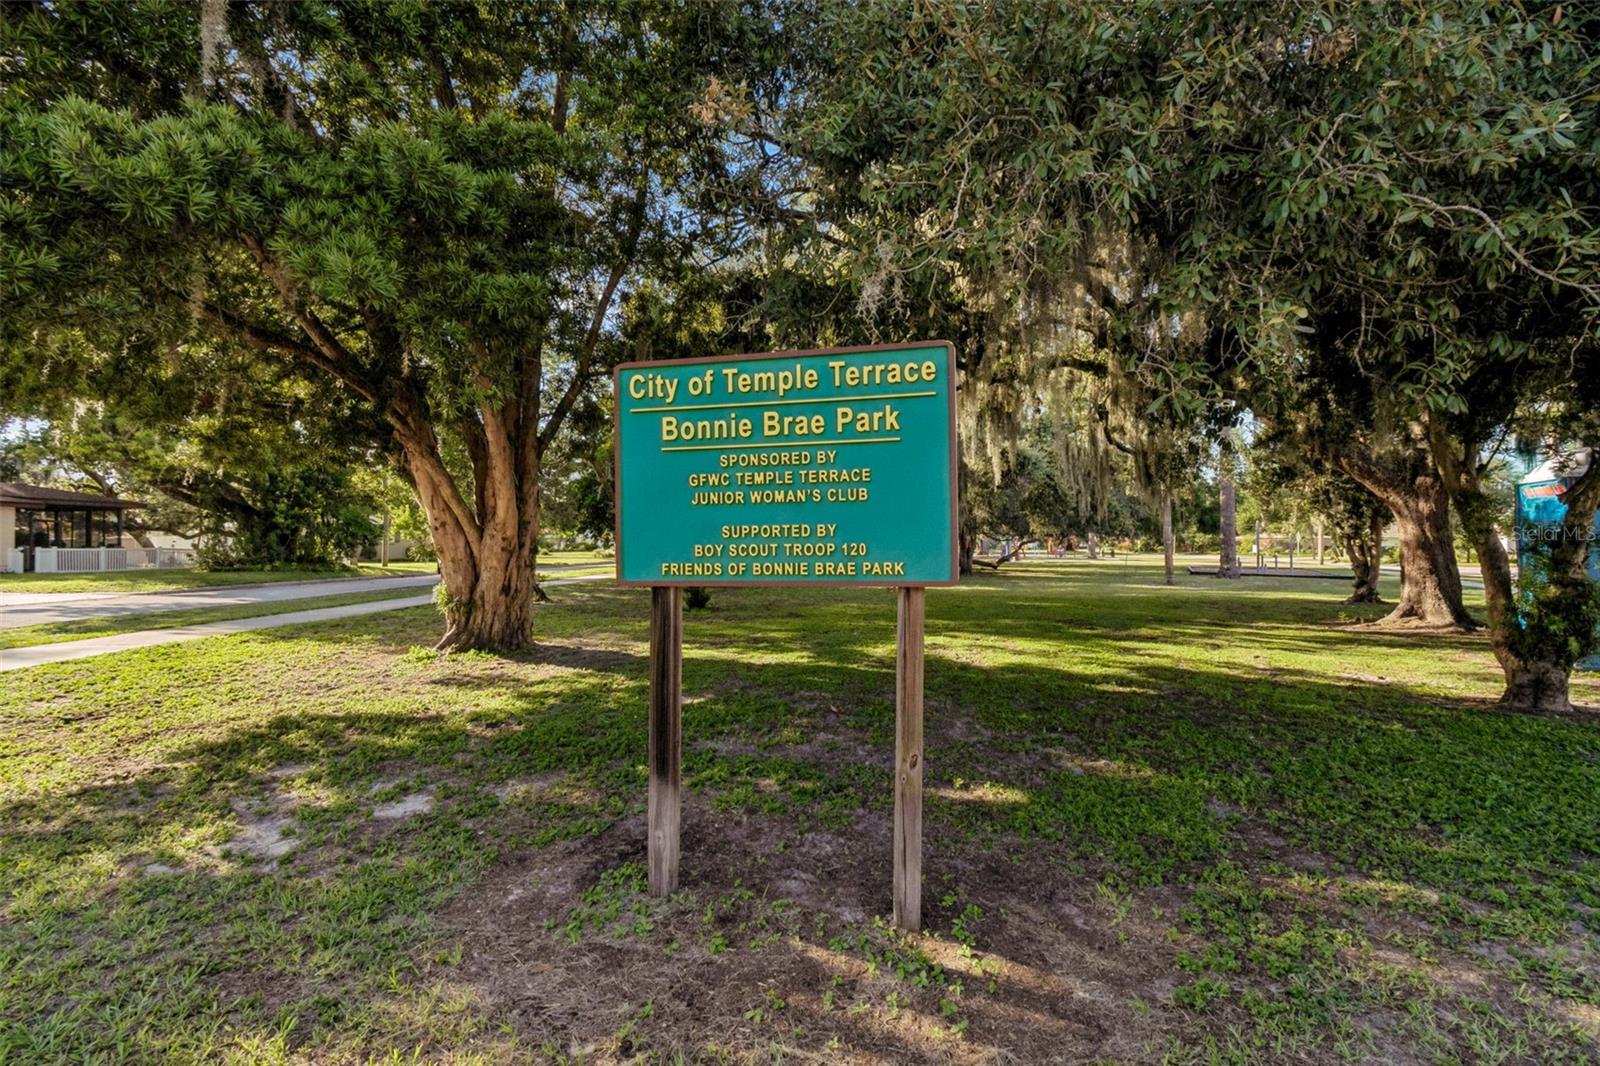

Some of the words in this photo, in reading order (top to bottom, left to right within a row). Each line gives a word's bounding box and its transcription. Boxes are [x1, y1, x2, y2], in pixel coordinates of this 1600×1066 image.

[629, 374, 679, 403] City
[688, 370, 714, 396] of
[722, 364, 818, 397] Temple
[828, 361, 937, 387] Terrace
[661, 413, 753, 441] Bonnie
[763, 412, 825, 437] Brae
[836, 405, 900, 433] Park
[719, 452, 811, 467] SPONSORED
[816, 451, 836, 464] BY
[688, 473, 729, 487] GFWC
[735, 471, 793, 485] TEMPLE
[799, 469, 871, 483] TERRACE
[691, 492, 745, 505] JUNIOR
[749, 489, 821, 504] WOMAN'S
[827, 488, 868, 502] CLUB
[721, 525, 811, 539] SUPPORTED
[816, 524, 836, 537] BY
[694, 544, 724, 557] BOY
[728, 544, 778, 557] SCOUT
[783, 543, 836, 557] TROOP
[841, 543, 867, 556] 120
[661, 563, 722, 576] FRIENDS
[727, 563, 746, 576] OF
[752, 562, 809, 576] BONNIE
[814, 562, 856, 576] BRAE
[862, 562, 904, 576] PARK
